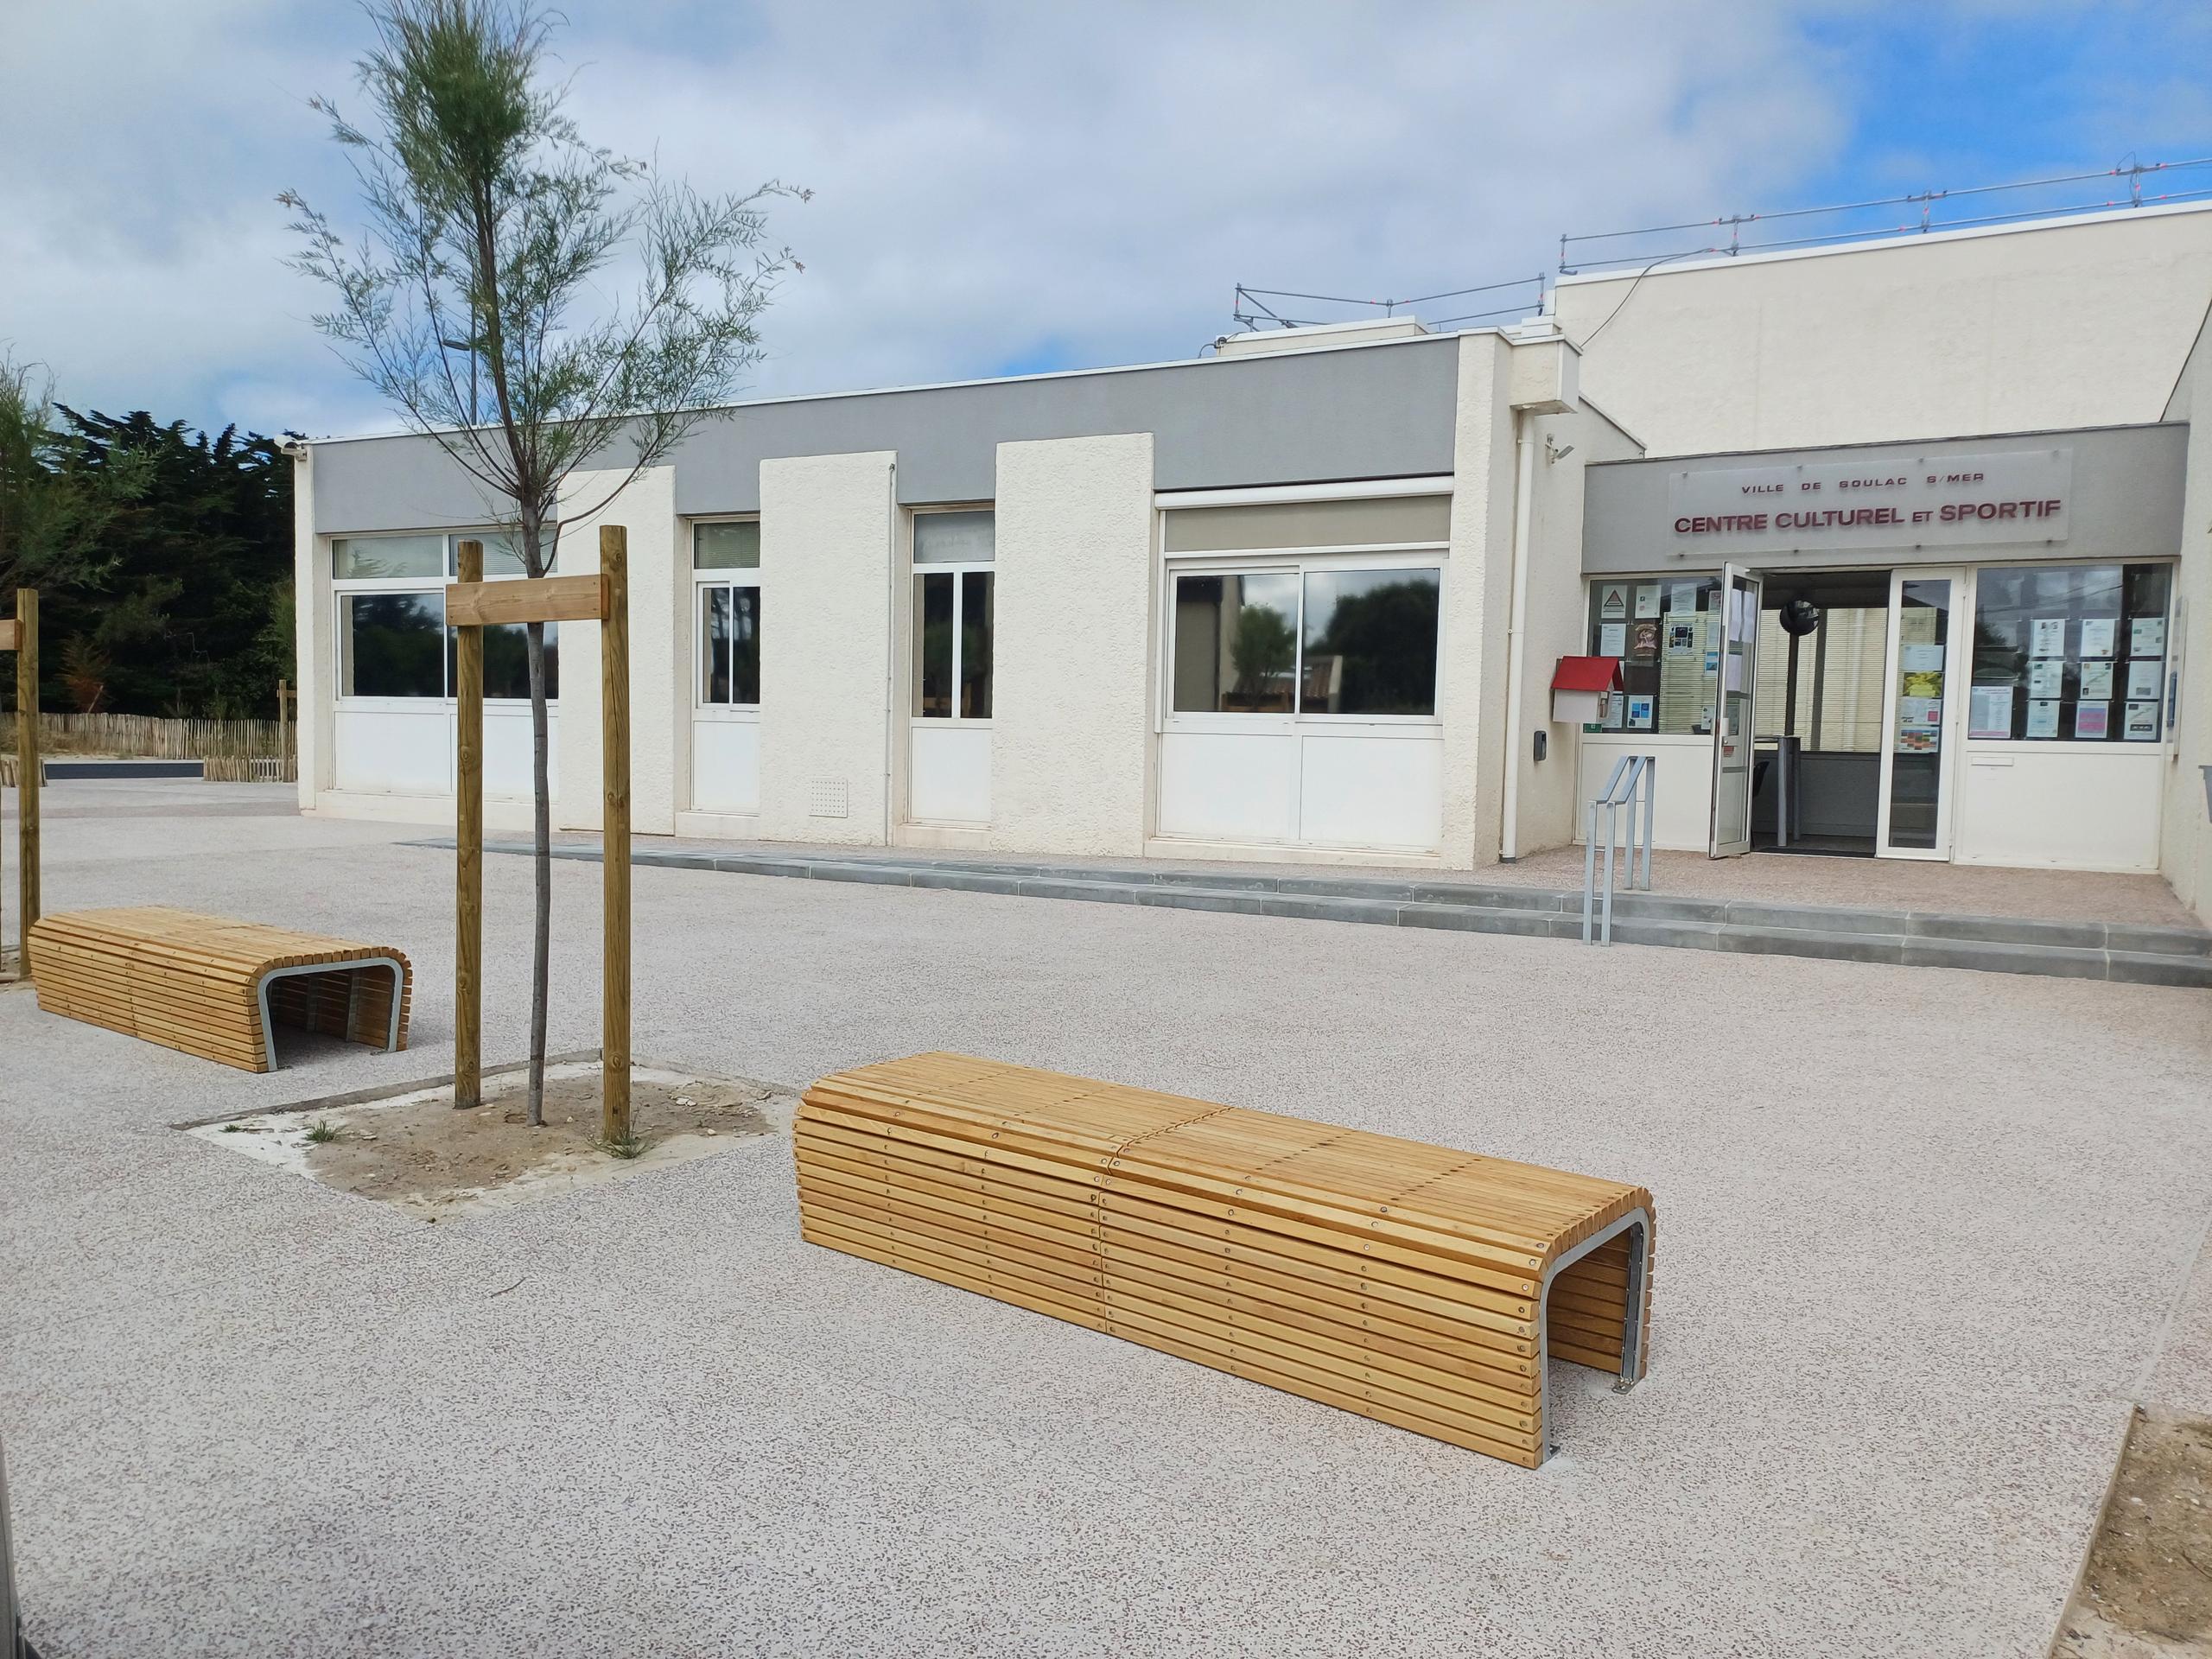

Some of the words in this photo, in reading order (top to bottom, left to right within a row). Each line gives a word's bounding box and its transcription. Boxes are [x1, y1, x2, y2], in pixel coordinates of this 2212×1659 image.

[1742, 484, 1784, 494] VILLE
[1802, 482, 1821, 491] DE
[1839, 478, 1908, 489] SOULAC
[1926, 473, 1984, 484] S/MER
[1674, 513, 1768, 533] CENTRE
[1775, 506, 1905, 528] CULTUREL
[1911, 511, 1934, 523] ET
[1939, 499, 2061, 521] SPORTIF
